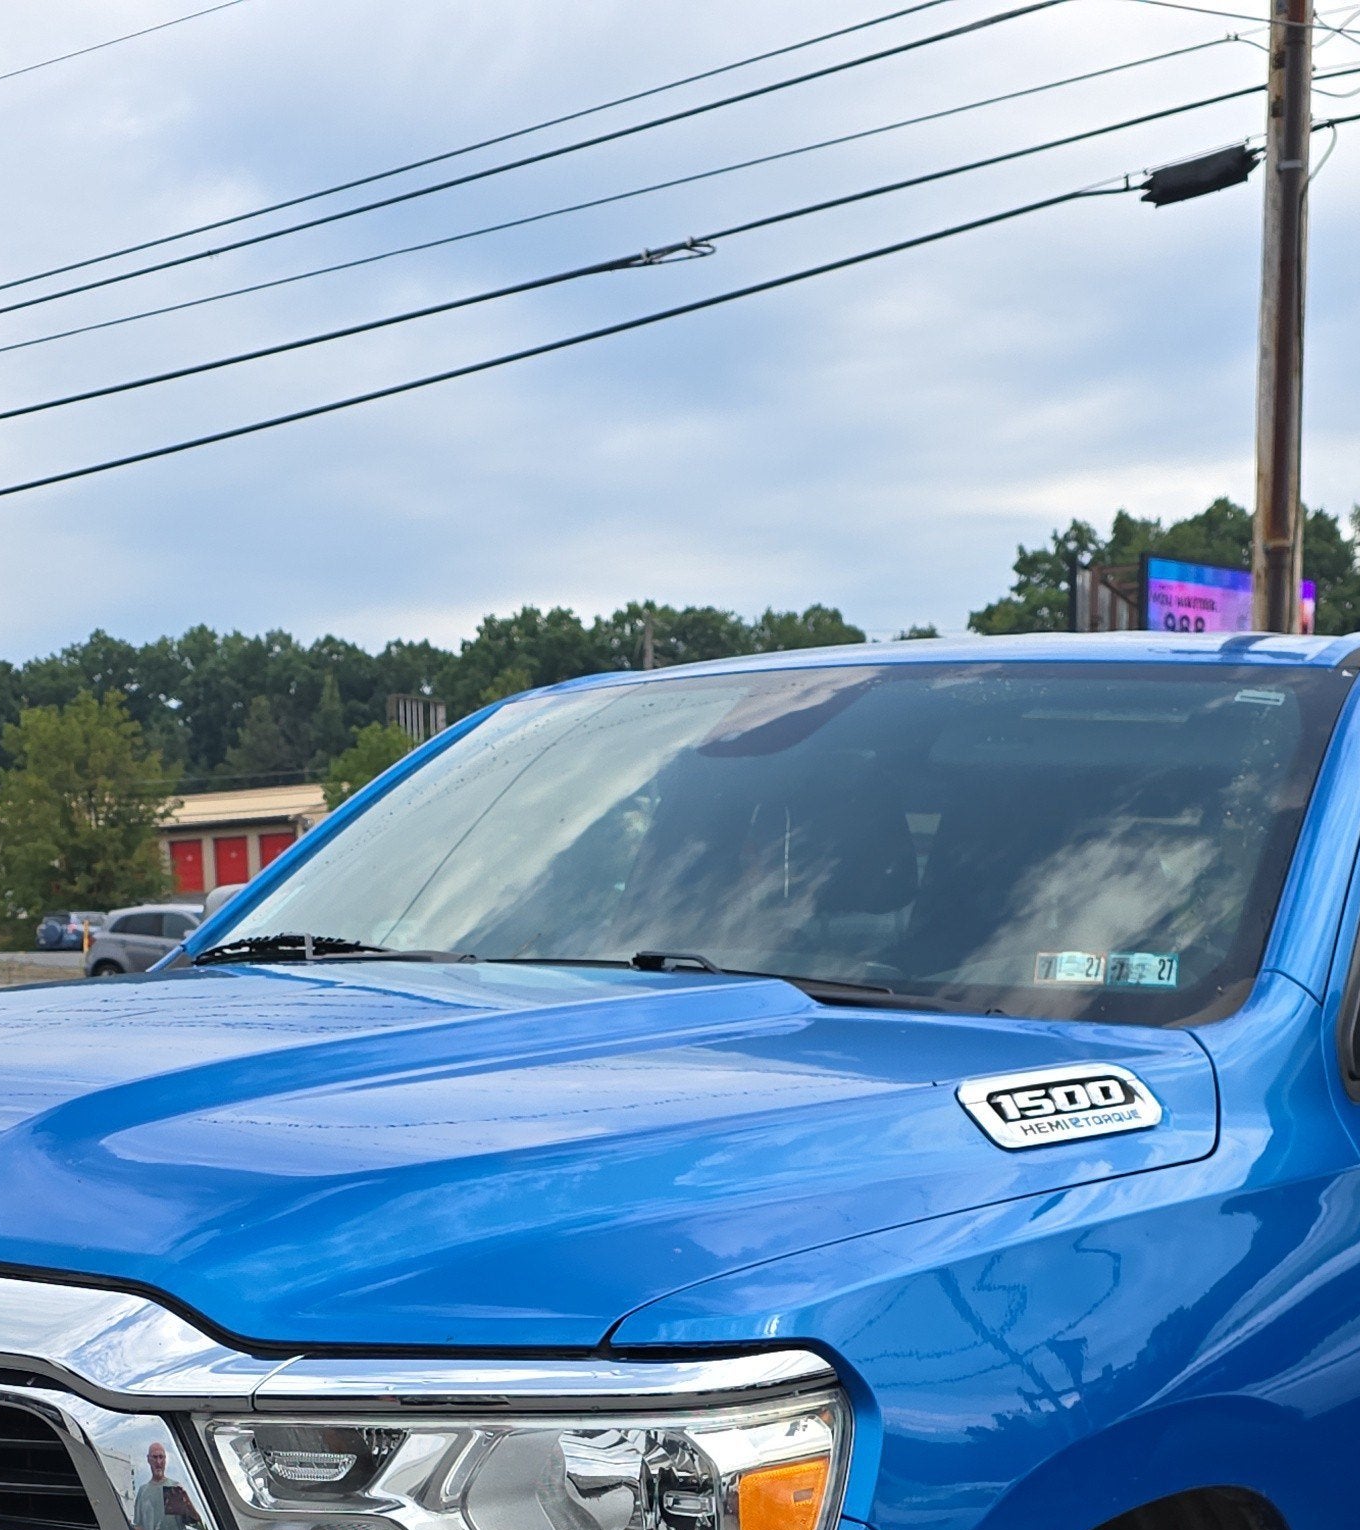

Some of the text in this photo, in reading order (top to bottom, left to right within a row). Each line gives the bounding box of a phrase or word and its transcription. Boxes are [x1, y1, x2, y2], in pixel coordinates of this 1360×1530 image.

[1085, 957, 1102, 977] 27
[1158, 958, 1174, 981] 27
[994, 1079, 1126, 1120] 1500
[1020, 1117, 1070, 1136] HEMI
